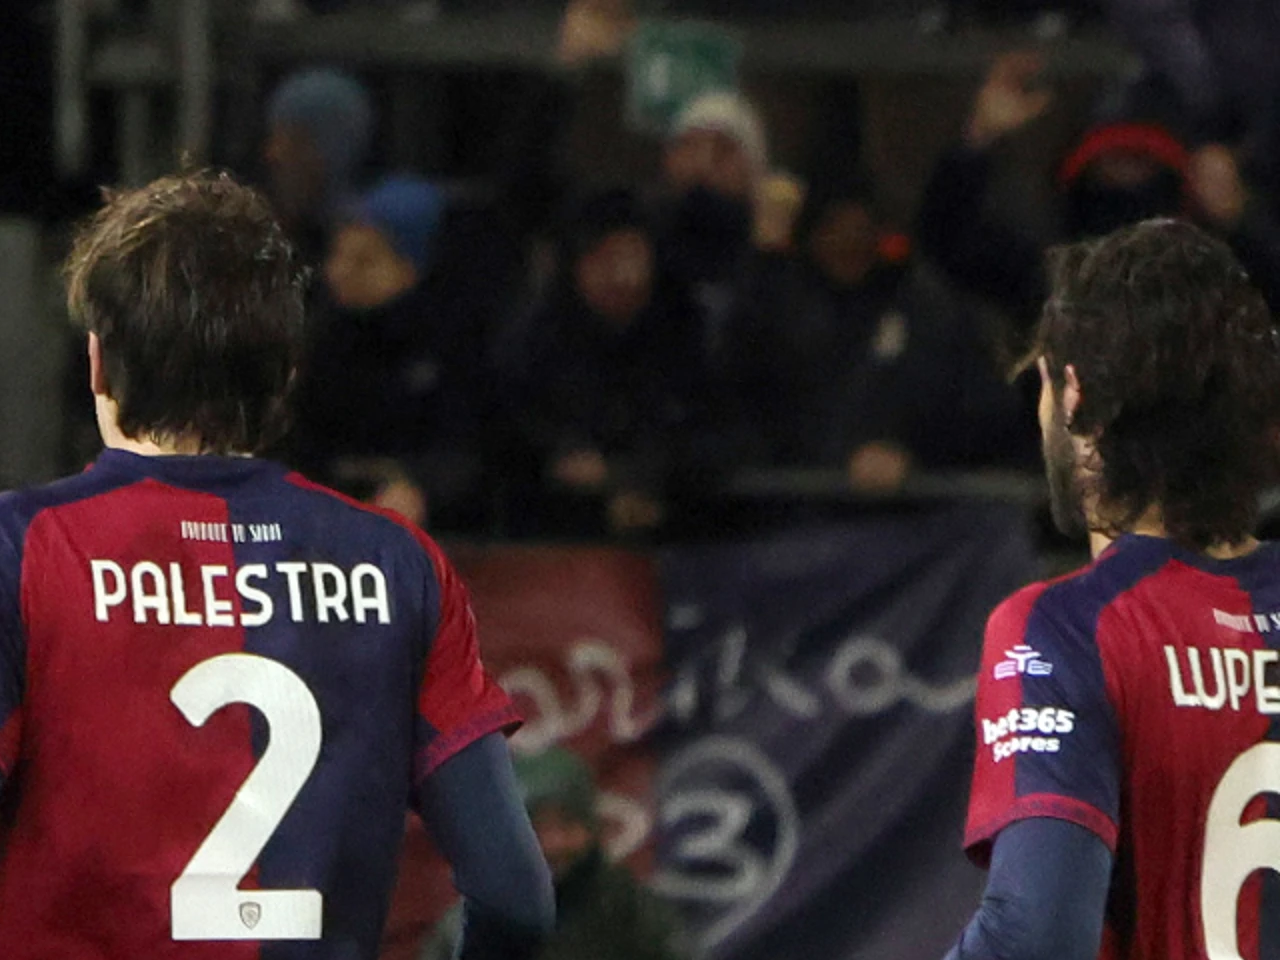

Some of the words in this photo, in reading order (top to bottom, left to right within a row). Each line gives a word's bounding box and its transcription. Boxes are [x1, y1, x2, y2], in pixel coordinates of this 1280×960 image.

[90, 559, 391, 627] PALESTRA
[1163, 644, 1280, 714] LUPE
[981, 706, 1076, 745] bet365
[170, 652, 323, 941] 2
